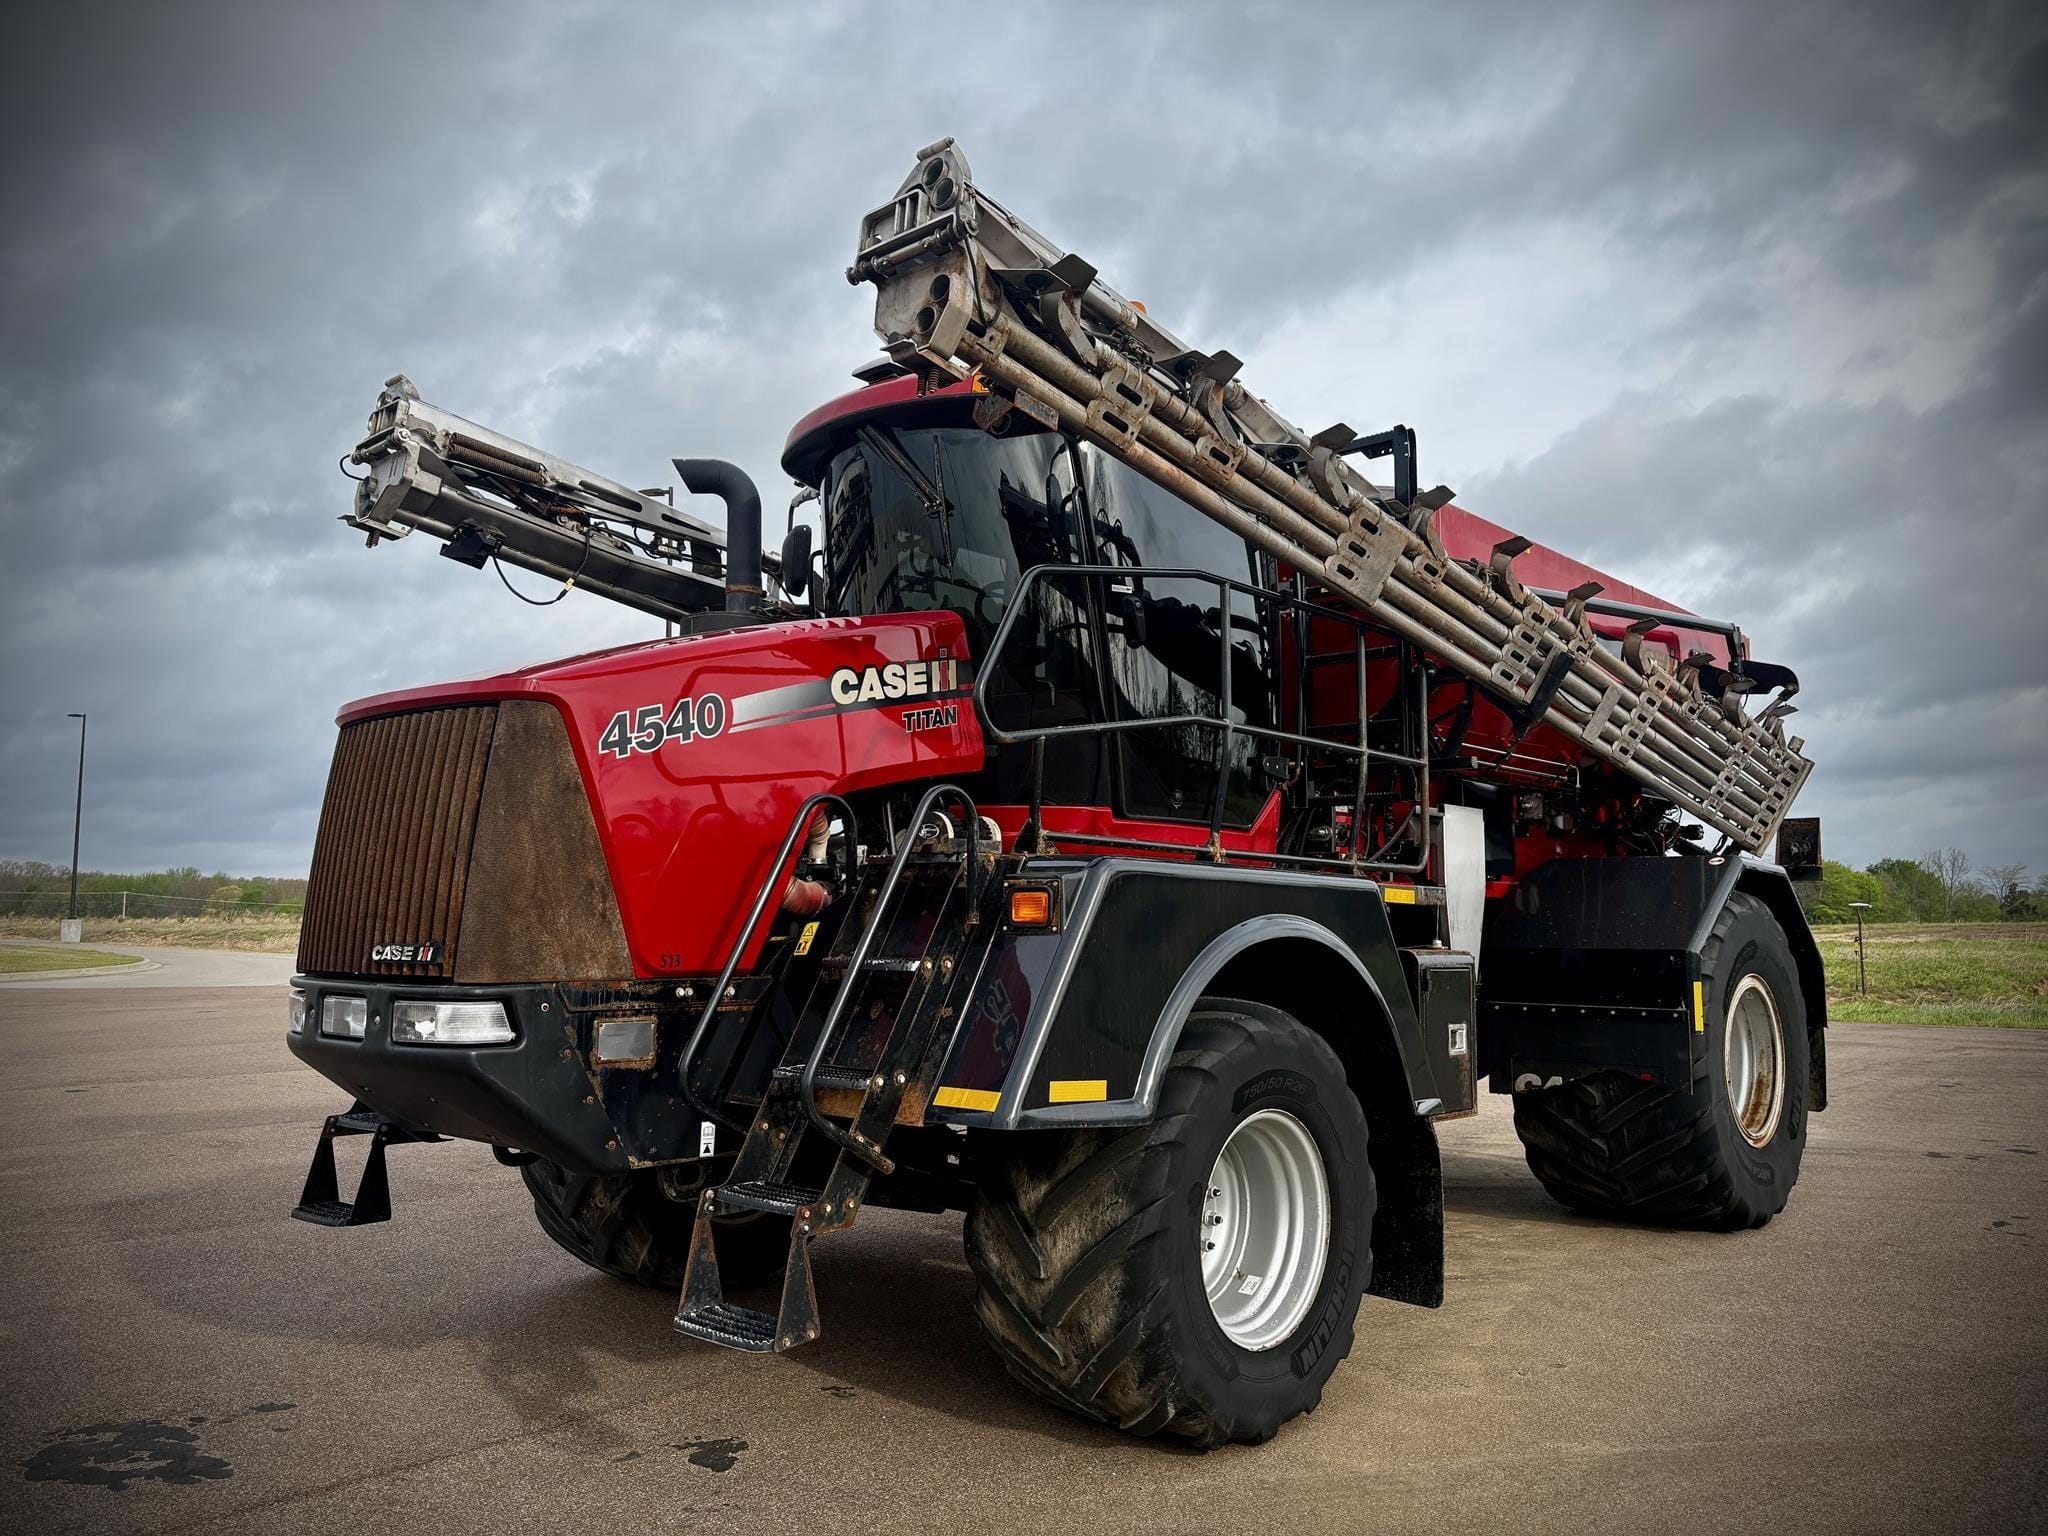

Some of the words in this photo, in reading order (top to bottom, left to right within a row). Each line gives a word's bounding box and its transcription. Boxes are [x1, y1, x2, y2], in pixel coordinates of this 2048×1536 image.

[829, 662, 929, 706] CASE
[599, 692, 727, 760] 4540
[902, 704, 958, 733] TITAN
[371, 943, 415, 962] CASE
[660, 952, 682, 969] 513
[1299, 1219, 1358, 1376] MICHELIN
